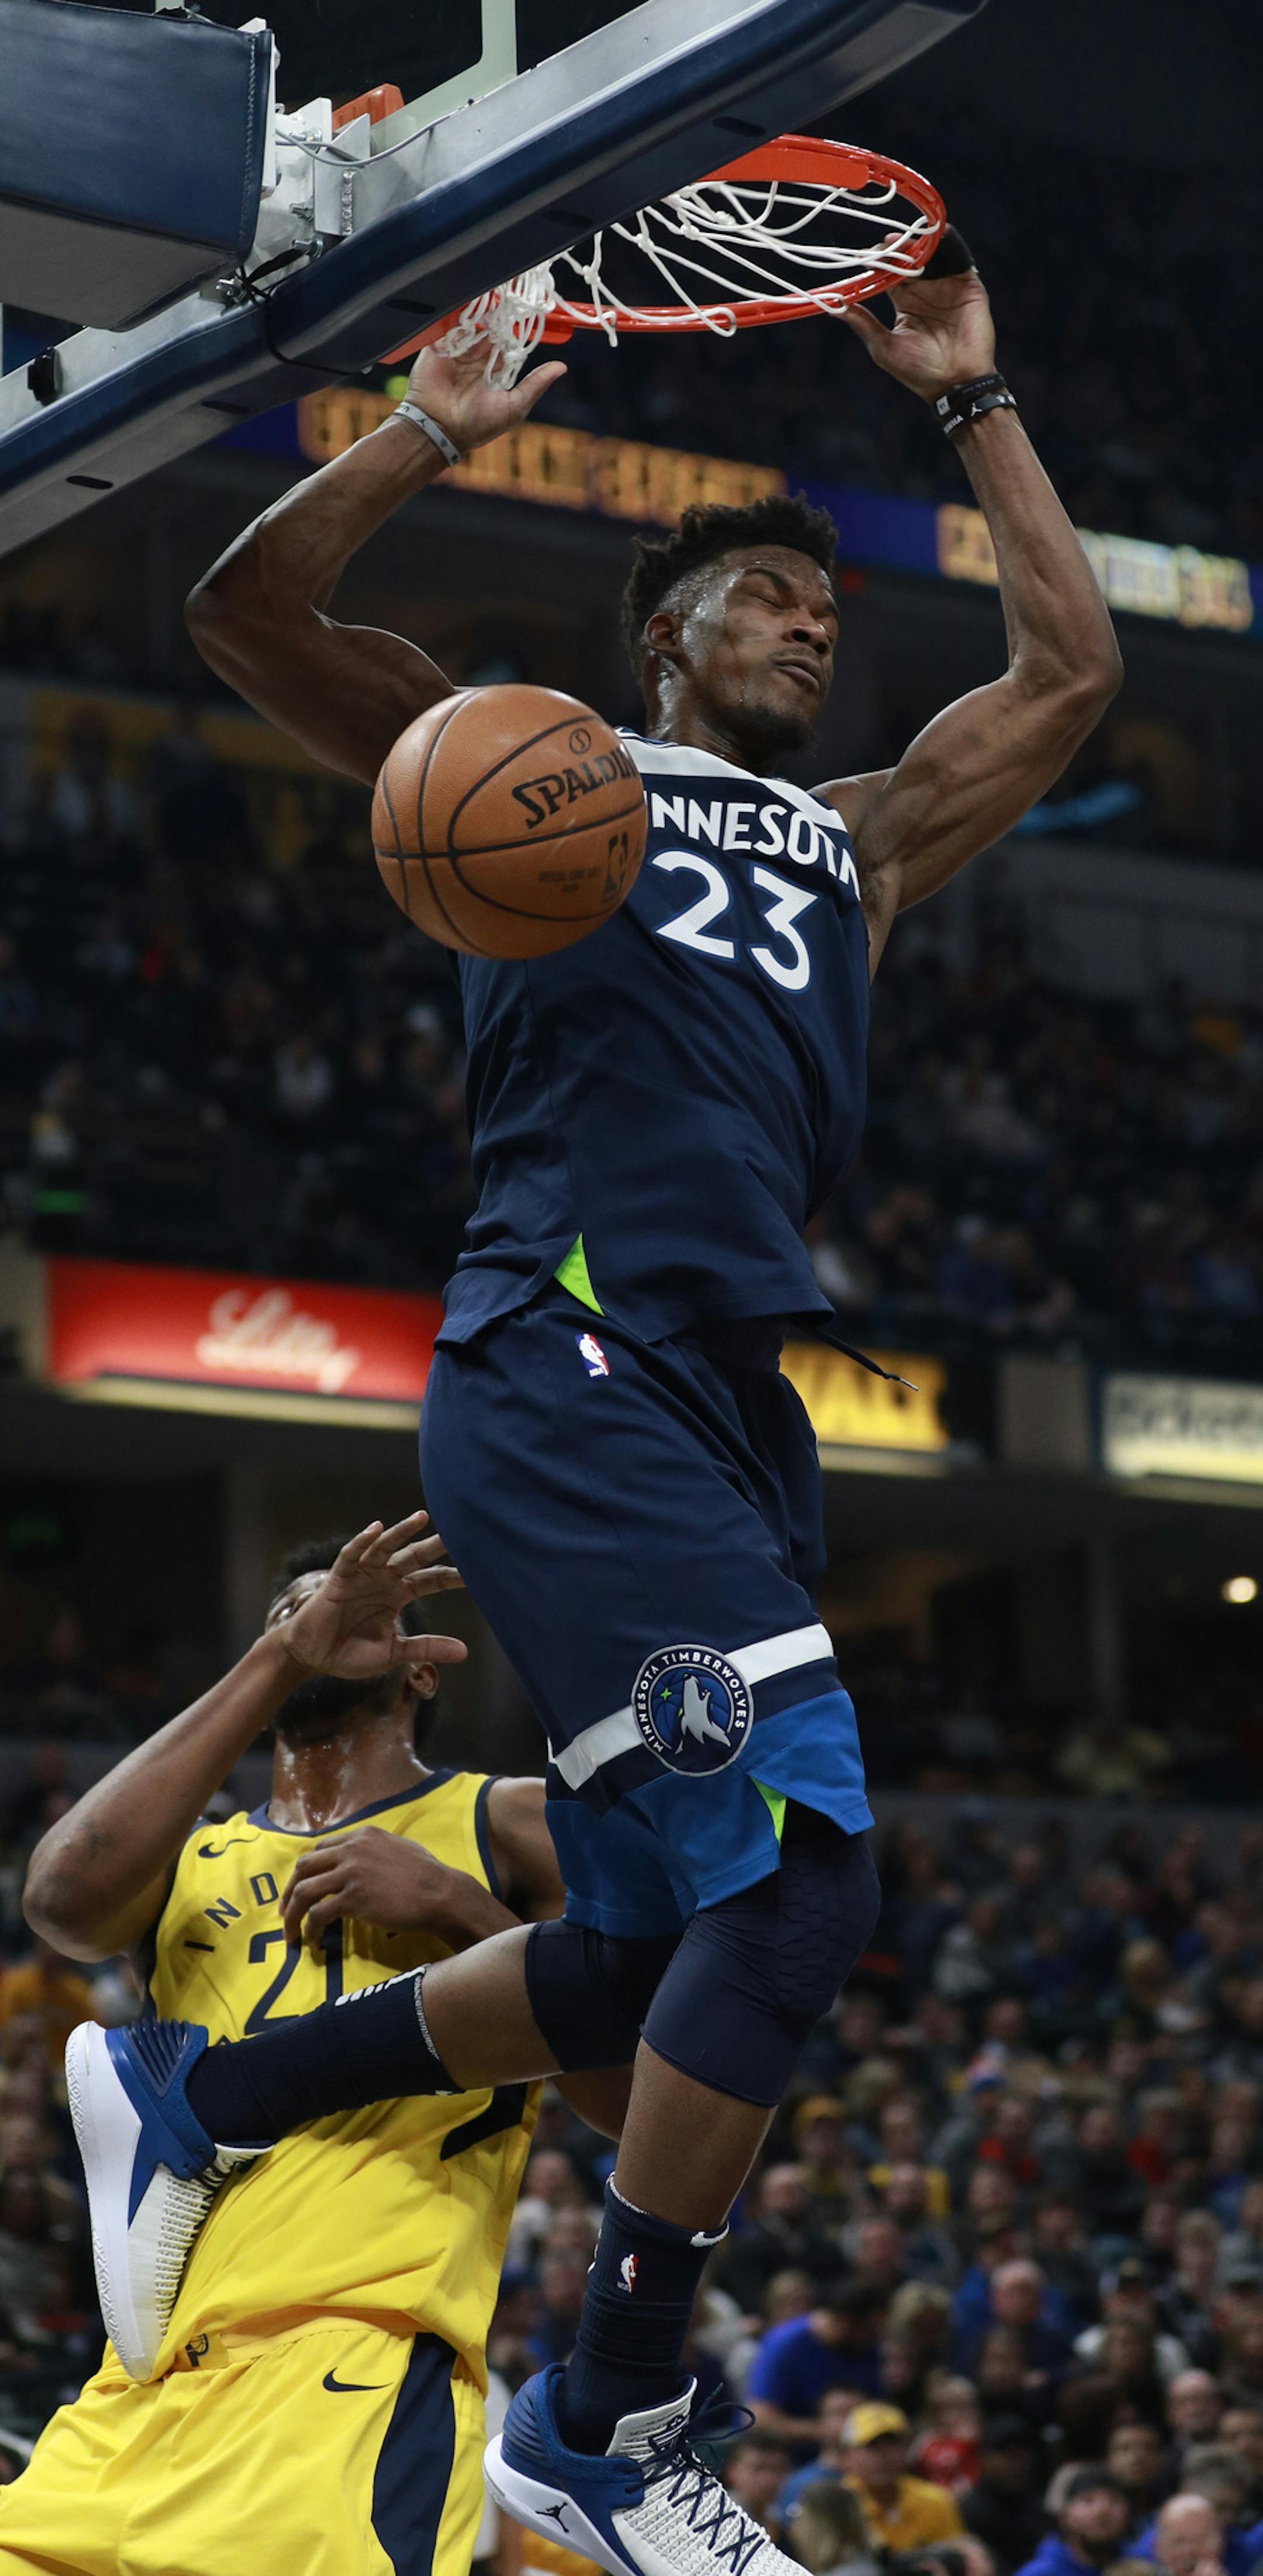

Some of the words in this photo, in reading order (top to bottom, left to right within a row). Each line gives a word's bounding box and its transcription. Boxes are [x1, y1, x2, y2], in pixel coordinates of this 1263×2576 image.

[512, 748, 637, 829] SPALDIN
[644, 790, 861, 901] NNESOTA
[650, 850, 819, 991] 23
[637, 1665, 664, 1753] MINNESOTA
[661, 1651, 747, 1729] TIMBERWOLVES
[244, 1916, 344, 2036] 21
